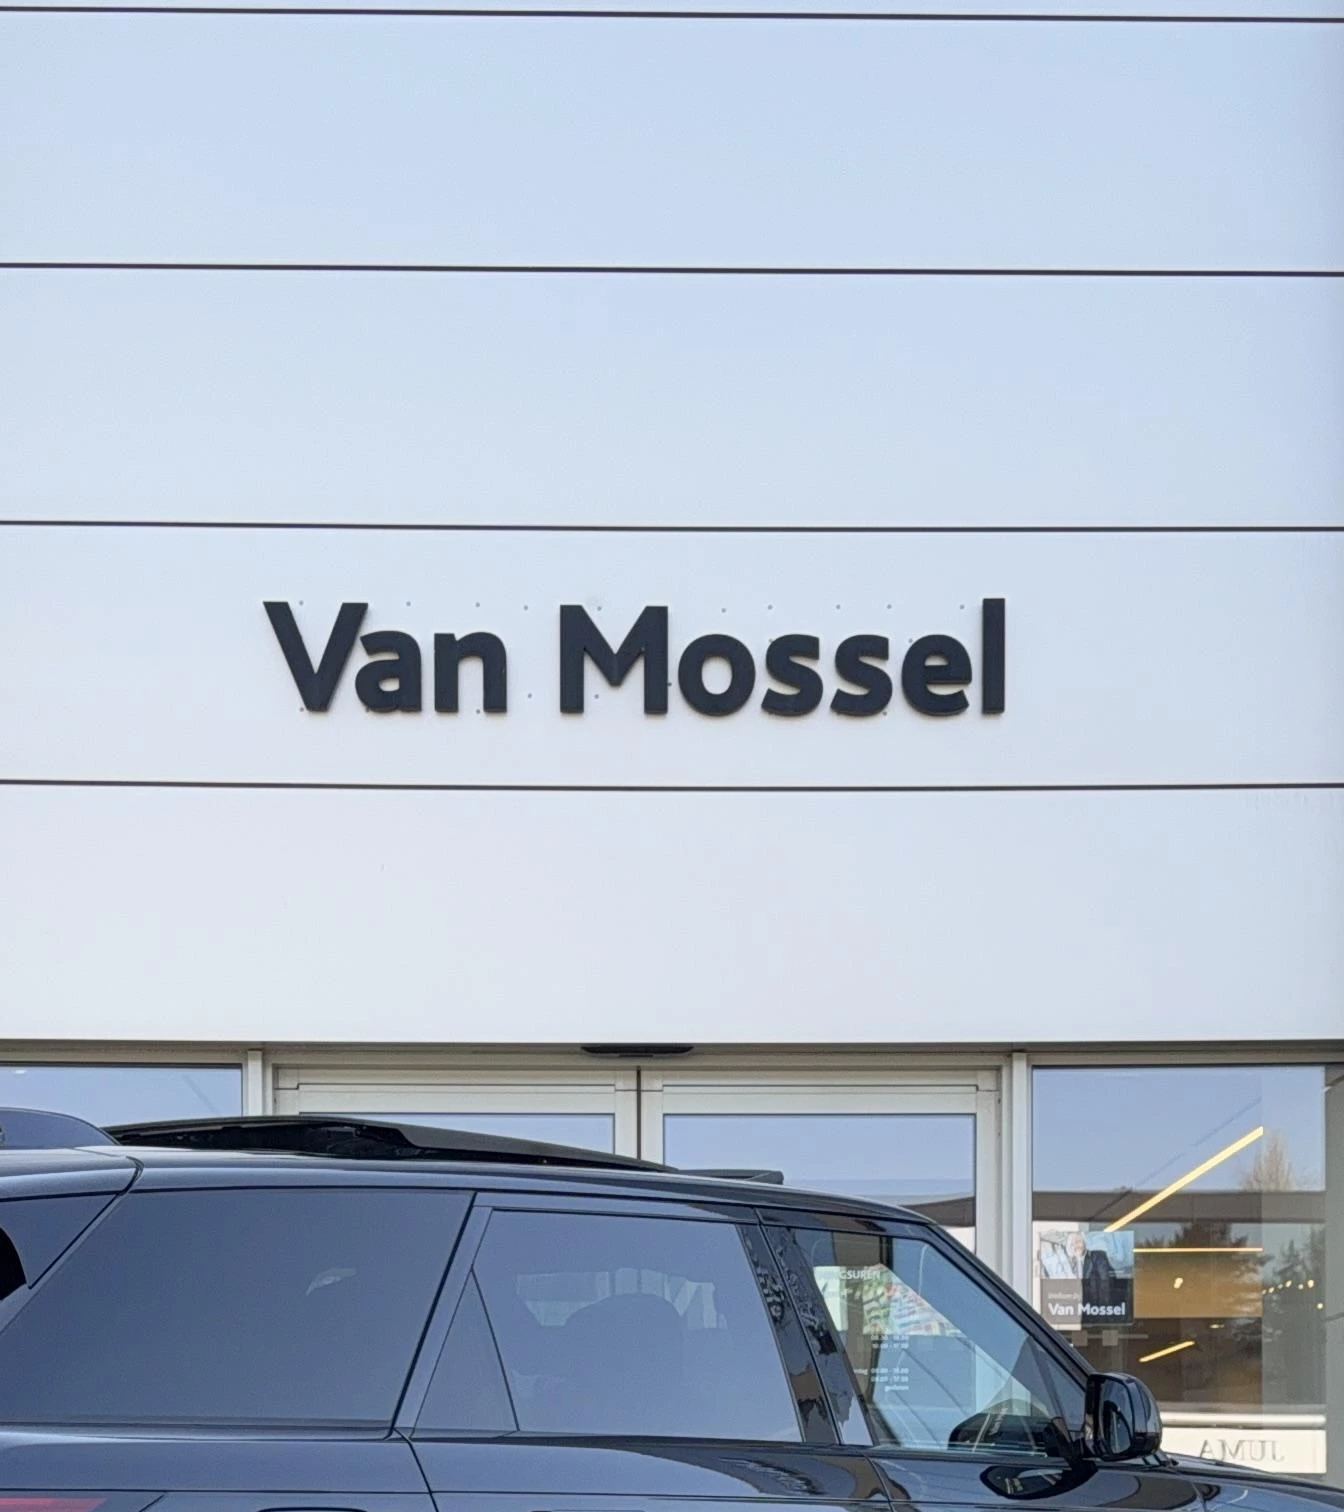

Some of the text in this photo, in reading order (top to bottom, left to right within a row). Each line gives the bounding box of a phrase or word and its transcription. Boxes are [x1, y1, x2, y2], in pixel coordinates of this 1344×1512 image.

[263, 598, 1006, 716] Van Mossel
[1047, 1301, 1126, 1316] Van Mossel
